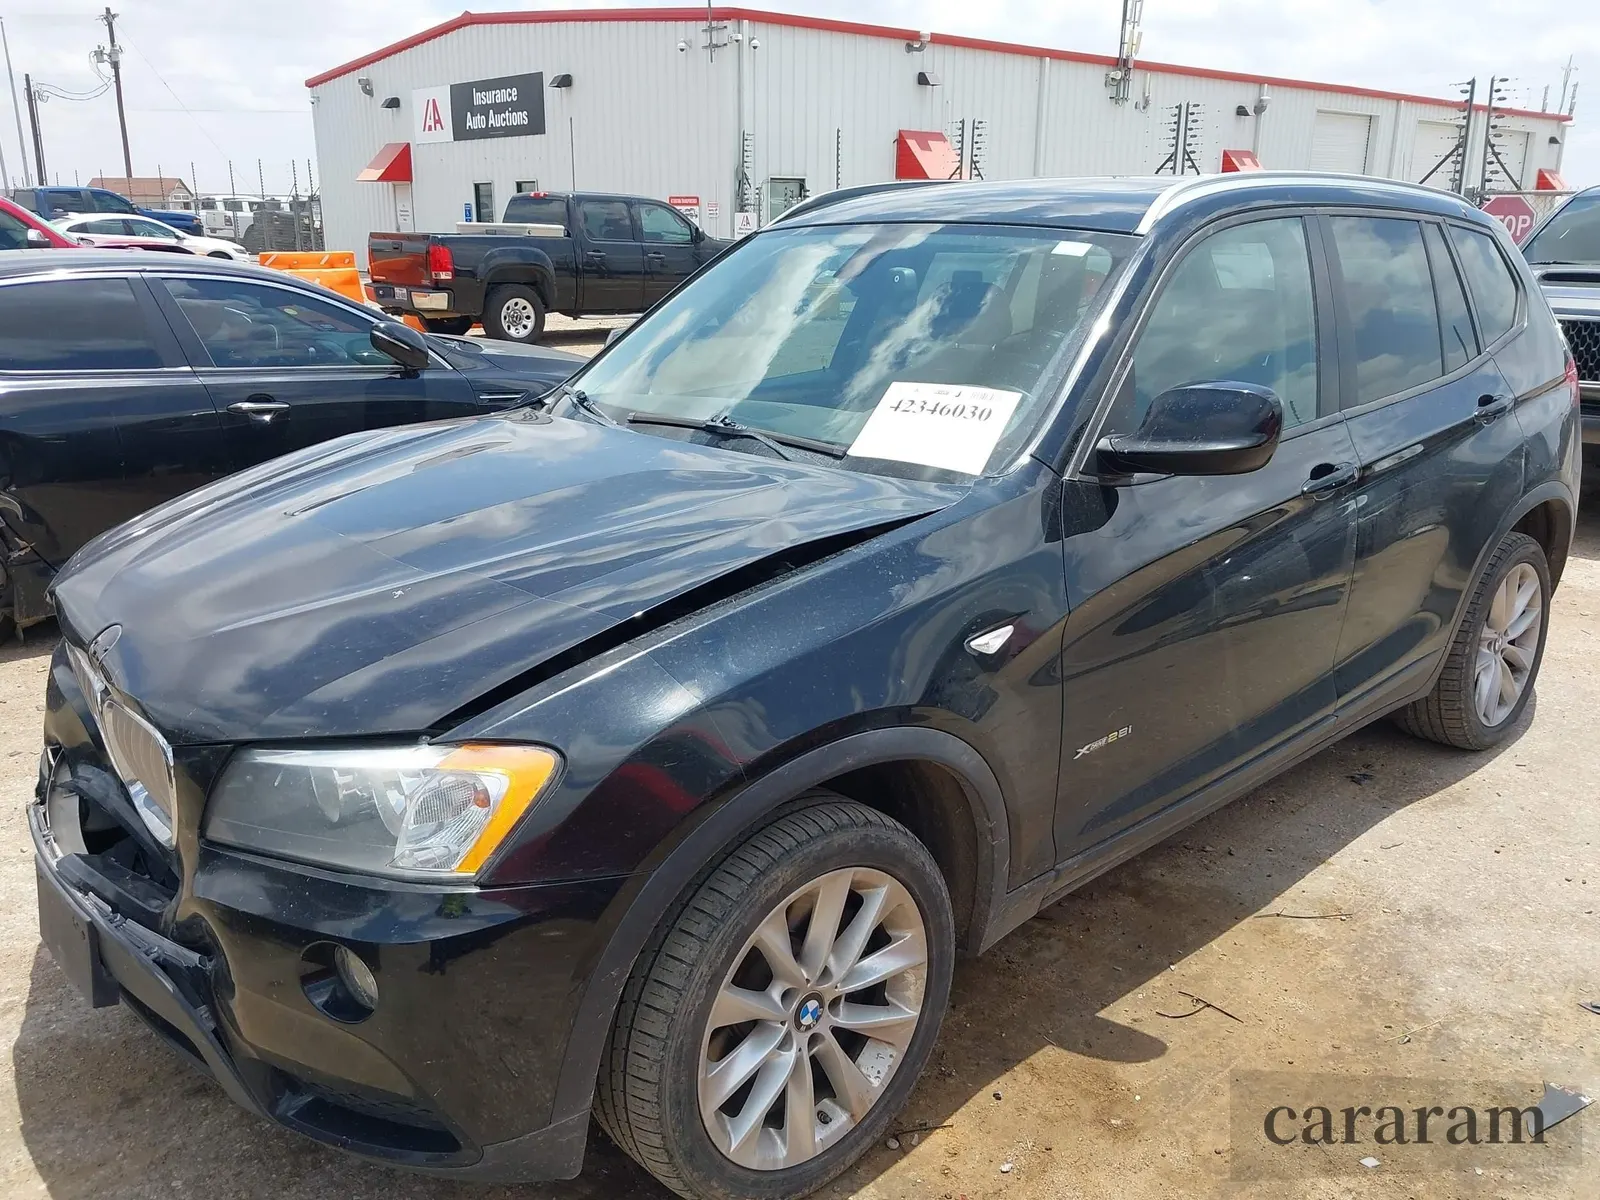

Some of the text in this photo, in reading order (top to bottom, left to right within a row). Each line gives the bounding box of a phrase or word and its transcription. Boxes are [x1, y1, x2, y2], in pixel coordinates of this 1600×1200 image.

[473, 87, 518, 106] Insurance
[466, 107, 529, 130] Auto Auctions
[1494, 214, 1531, 237] OP
[889, 399, 993, 421] 42346030
